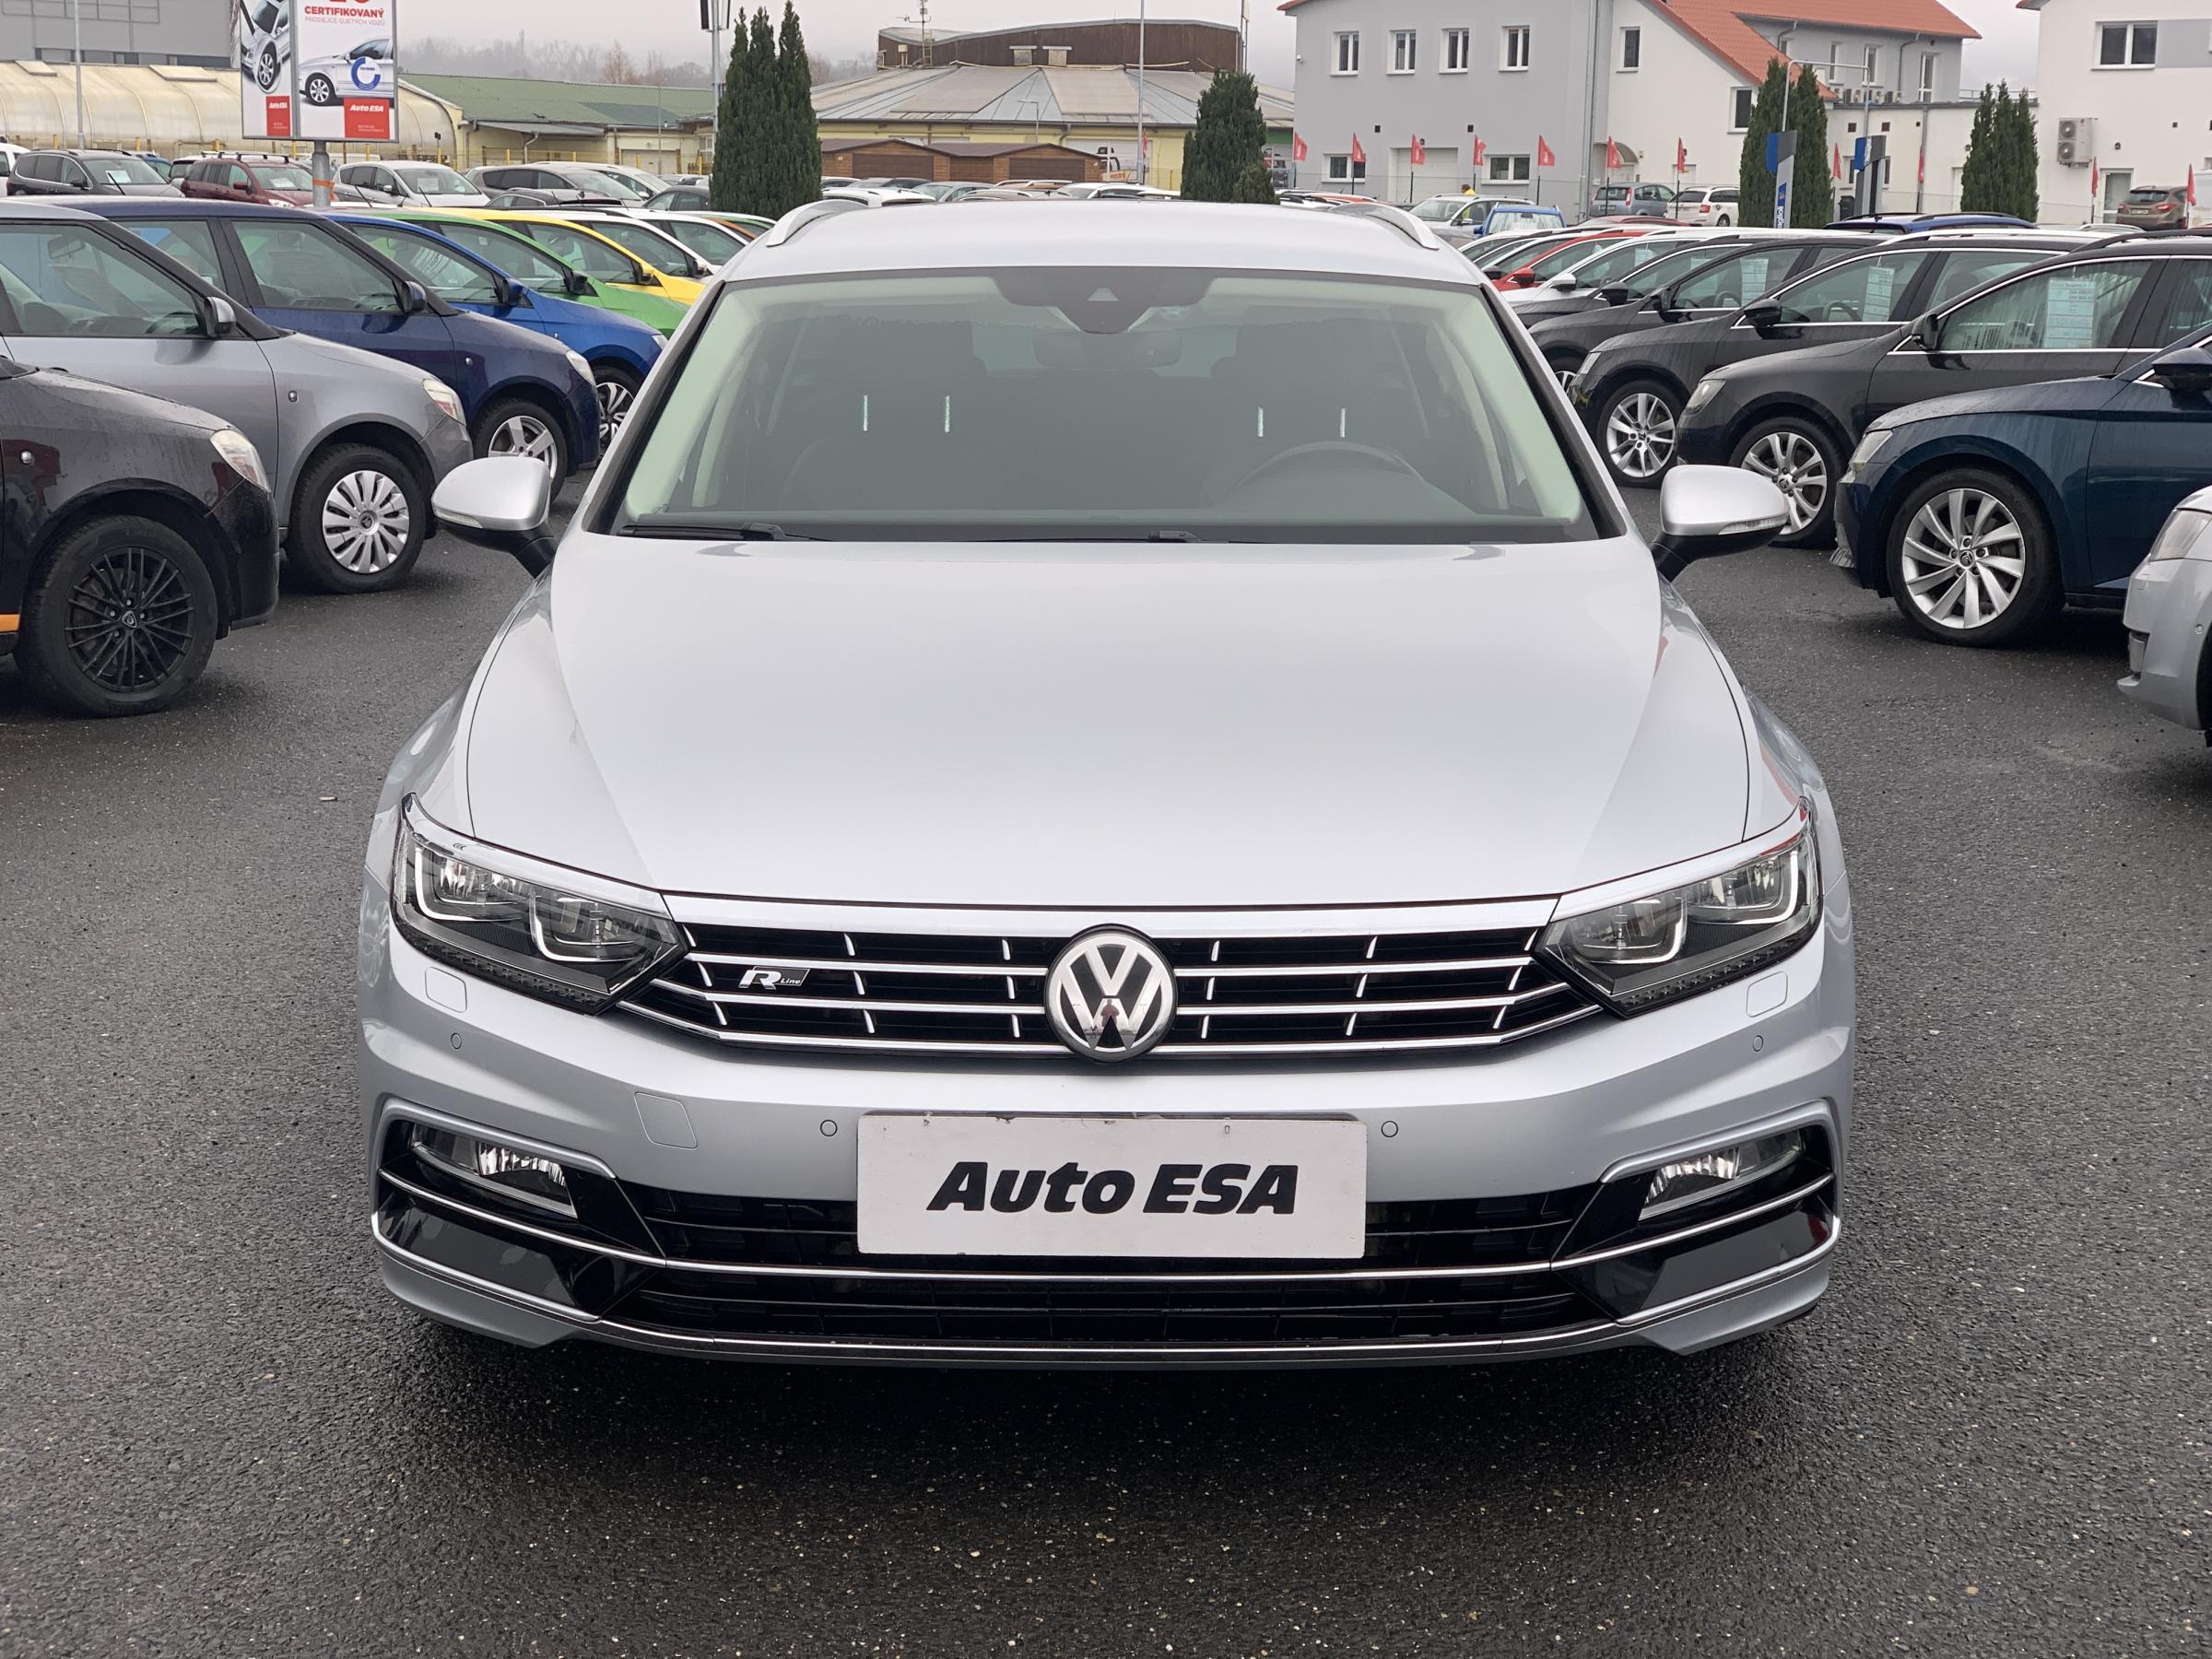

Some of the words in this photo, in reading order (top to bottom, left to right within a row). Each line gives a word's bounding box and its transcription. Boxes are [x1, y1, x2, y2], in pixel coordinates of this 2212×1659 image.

[304, 6, 384, 18] CERTIFIKOVANÝ
[738, 970, 782, 990] R
[926, 1162, 1135, 1214] Auto
[1143, 1164, 1298, 1215] ESA
